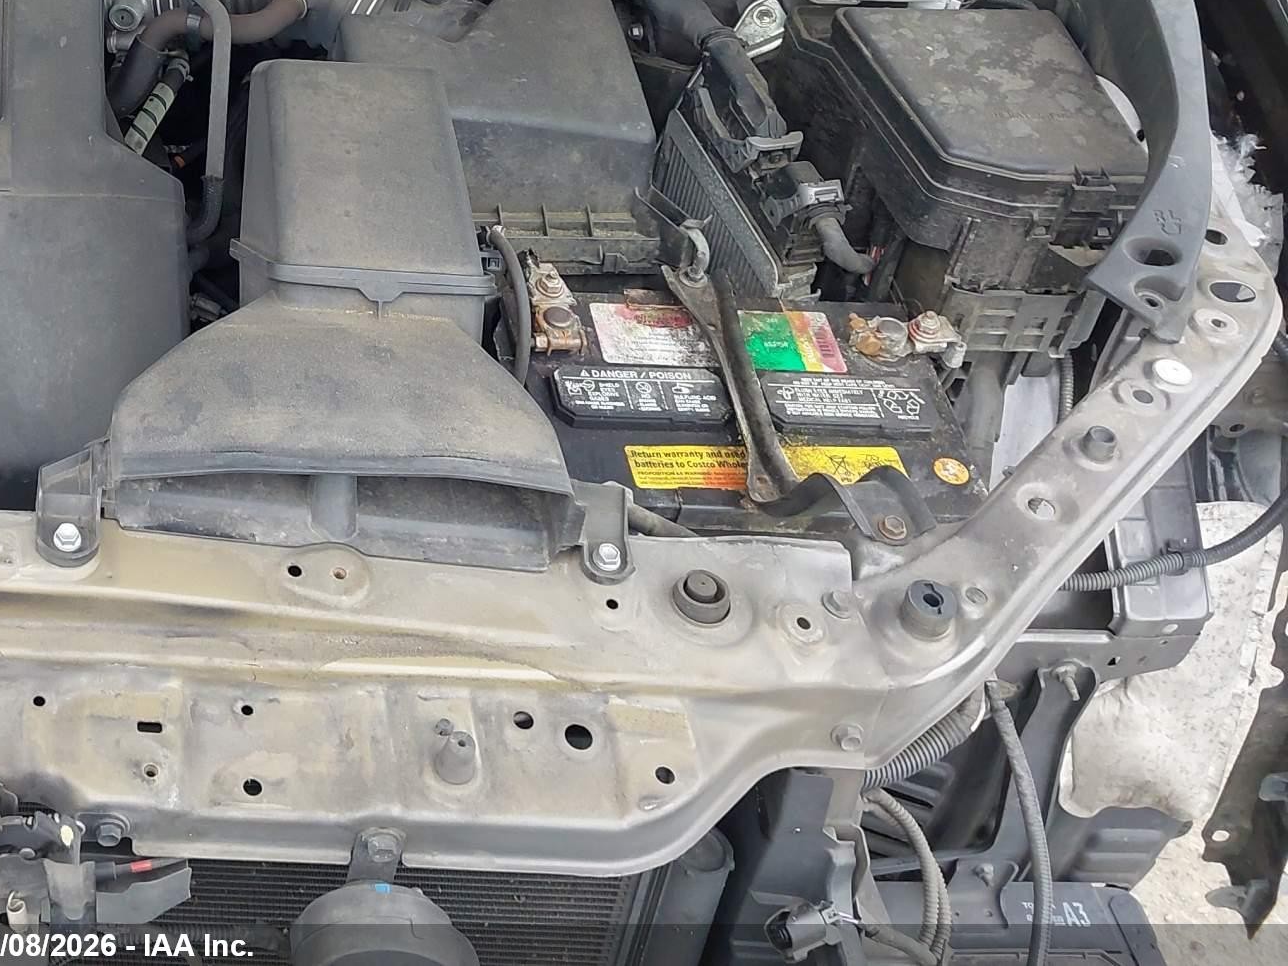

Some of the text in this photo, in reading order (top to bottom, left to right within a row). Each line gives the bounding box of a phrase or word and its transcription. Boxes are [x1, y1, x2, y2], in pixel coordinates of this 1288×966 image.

[591, 369, 638, 379] DANGER
[648, 371, 692, 380] POISON
[630, 450, 747, 460] Return warranty and used
[1062, 902, 1091, 927] A3
